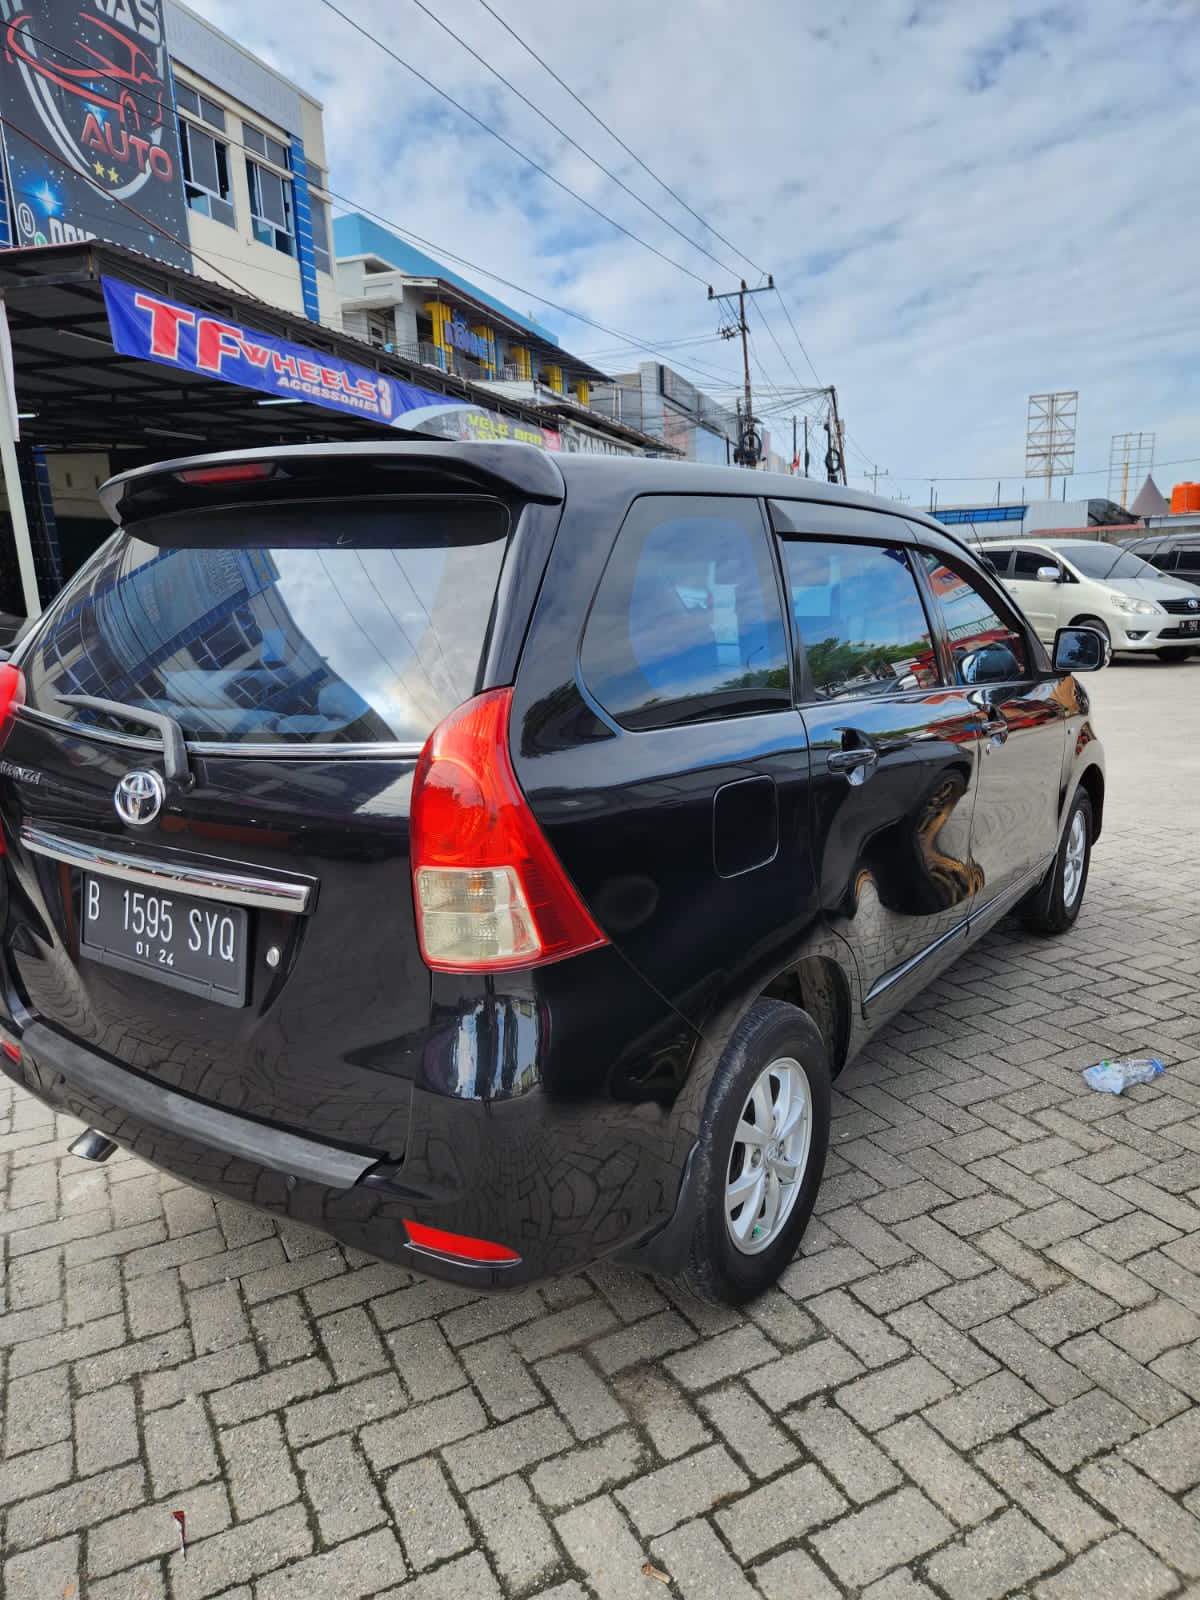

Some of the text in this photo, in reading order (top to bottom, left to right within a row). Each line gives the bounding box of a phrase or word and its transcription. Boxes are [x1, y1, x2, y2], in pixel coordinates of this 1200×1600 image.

[81, 113, 173, 181] AUTO
[134, 292, 242, 373] TF
[236, 338, 378, 401] WHEELS
[377, 377, 392, 418] 3
[88, 881, 235, 963] B 1595 SYQ
[136, 942, 175, 967] 01 24
